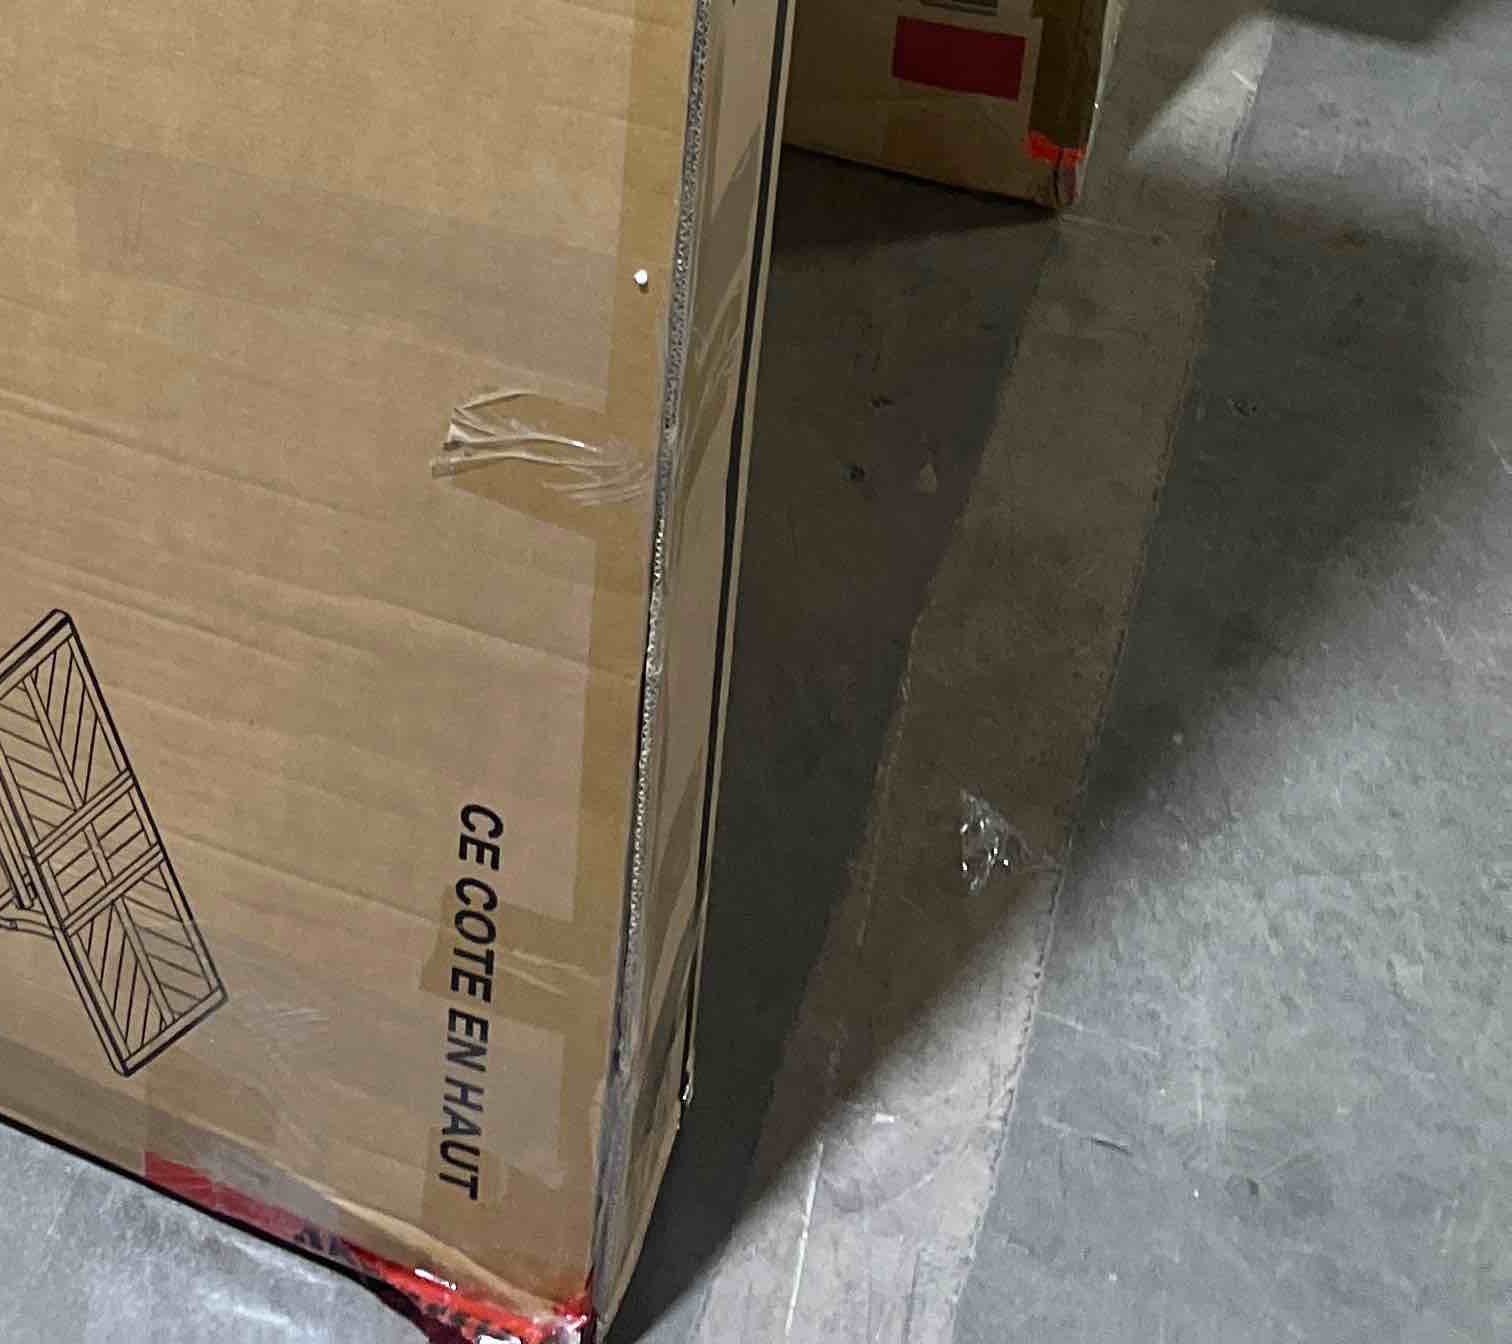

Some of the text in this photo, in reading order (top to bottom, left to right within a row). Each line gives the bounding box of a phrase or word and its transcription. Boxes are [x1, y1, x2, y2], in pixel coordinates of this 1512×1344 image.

[439, 805, 503, 1200] CE COTE EN HAUT
